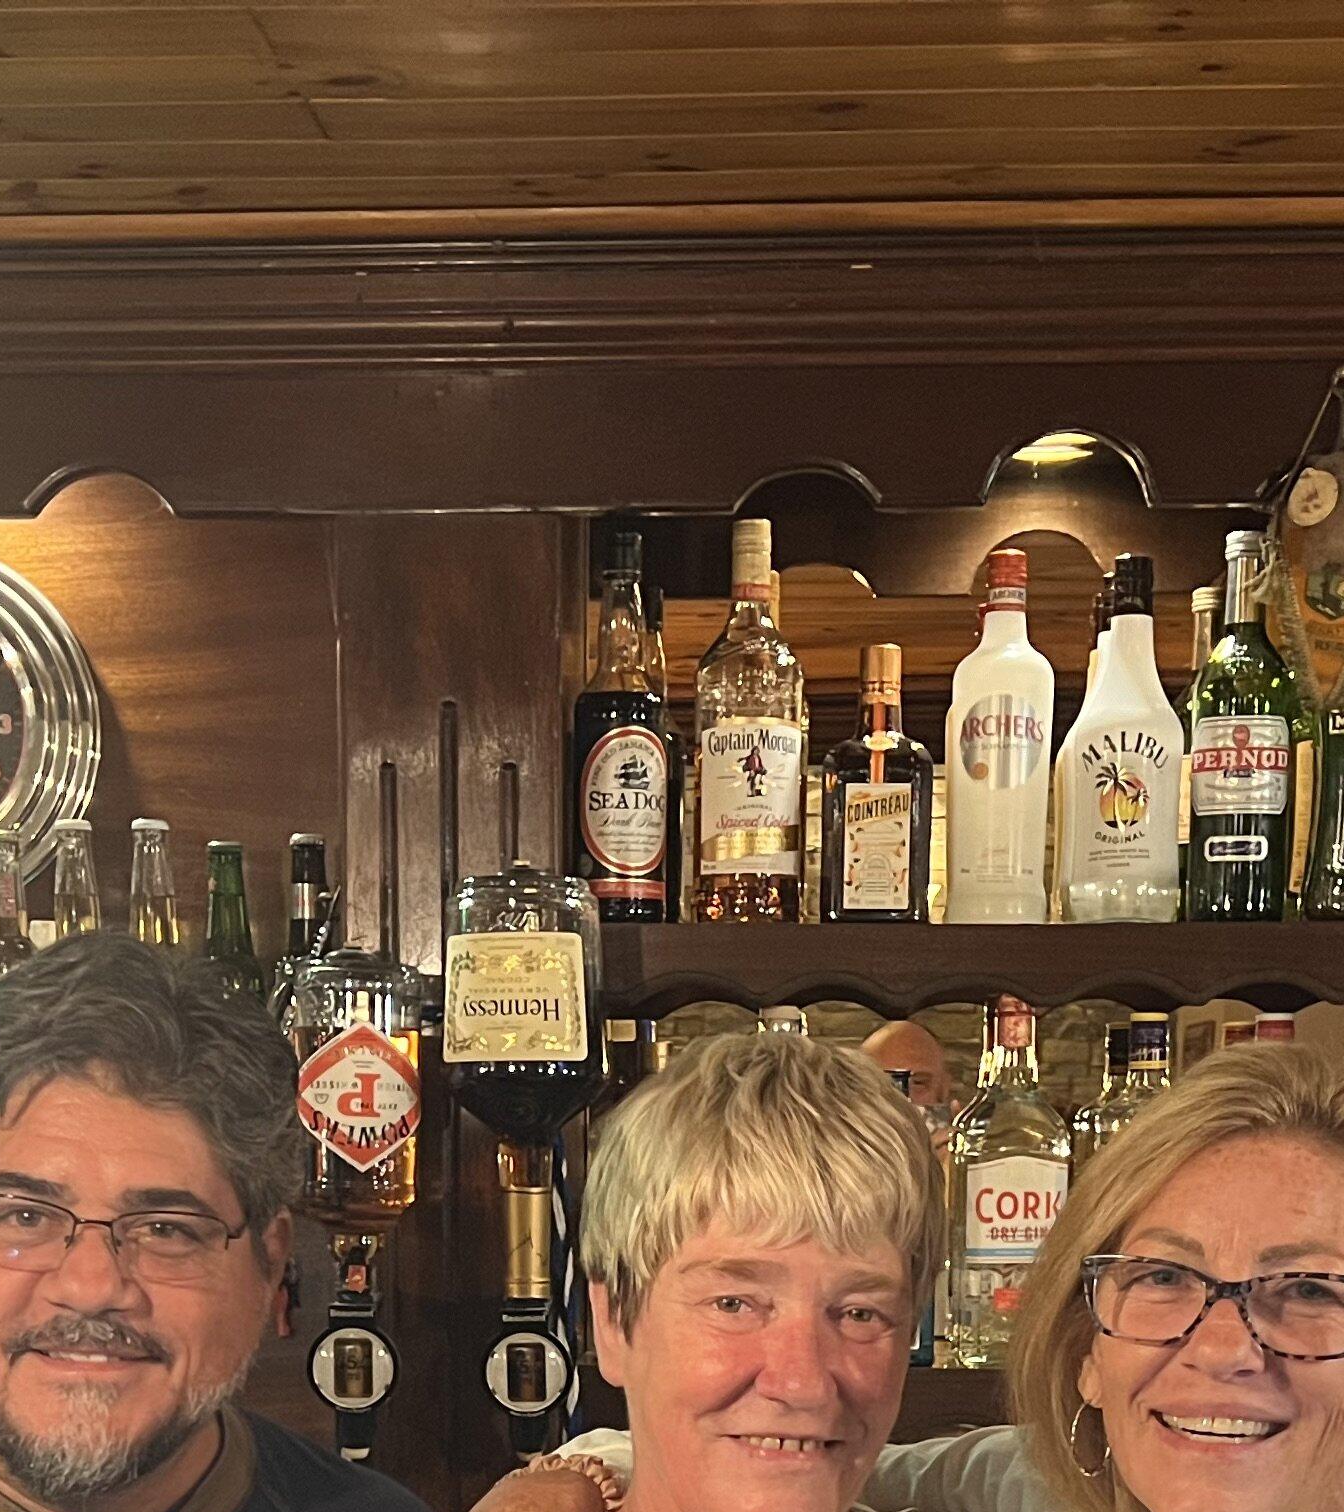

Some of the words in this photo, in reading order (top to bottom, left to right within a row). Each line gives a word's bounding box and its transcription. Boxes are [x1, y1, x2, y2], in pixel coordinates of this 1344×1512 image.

[0, 713, 13, 734] 3
[961, 714, 1045, 743] ARCHERS
[707, 729, 754, 757] Captain
[754, 728, 798, 754] Morgan
[1080, 731, 1170, 773] MALIBU
[1192, 750, 1289, 771] PERNOD
[589, 790, 629, 811] SEA
[847, 793, 910, 823] COINTREAU
[715, 812, 761, 829] Spiced
[1094, 830, 1146, 845] ORIGINAL
[462, 995, 561, 1022] Hennessy
[337, 1074, 381, 1119] P
[309, 1110, 410, 1150] POWERS
[975, 1187, 1062, 1224] CORK
